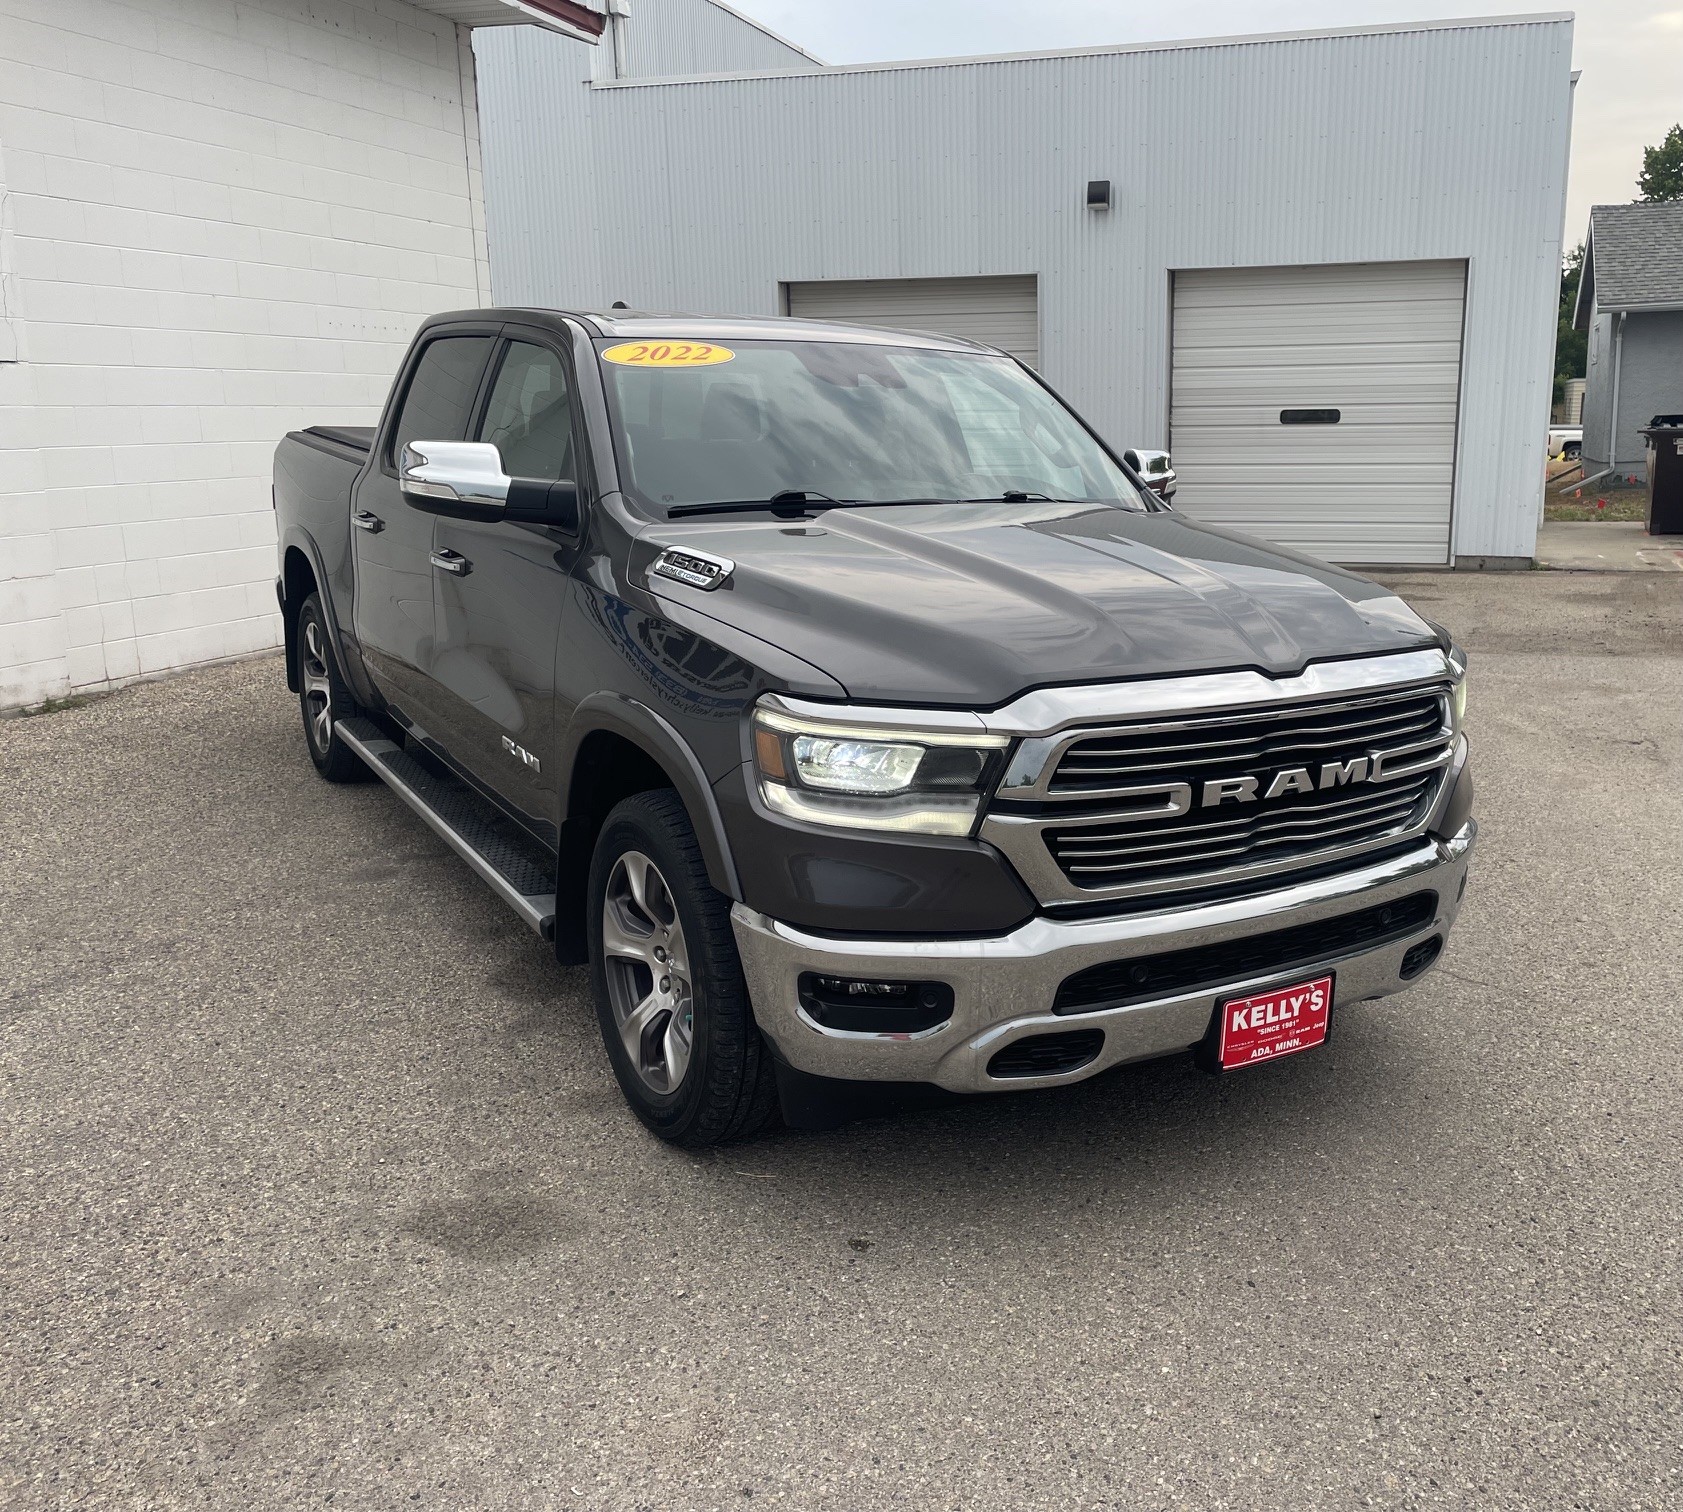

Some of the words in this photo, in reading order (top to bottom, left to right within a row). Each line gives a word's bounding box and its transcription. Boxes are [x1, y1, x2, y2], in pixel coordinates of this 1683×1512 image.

[627, 345, 713, 362] 2022
[660, 564, 678, 575] HEMI
[664, 553, 720, 577] 1500
[502, 735, 541, 773] RAM
[1202, 757, 1368, 807] RAM
[1232, 989, 1324, 1032] KELLY'S
[1250, 1045, 1273, 1059] ADA,
[1275, 1037, 1302, 1052] MINN.
